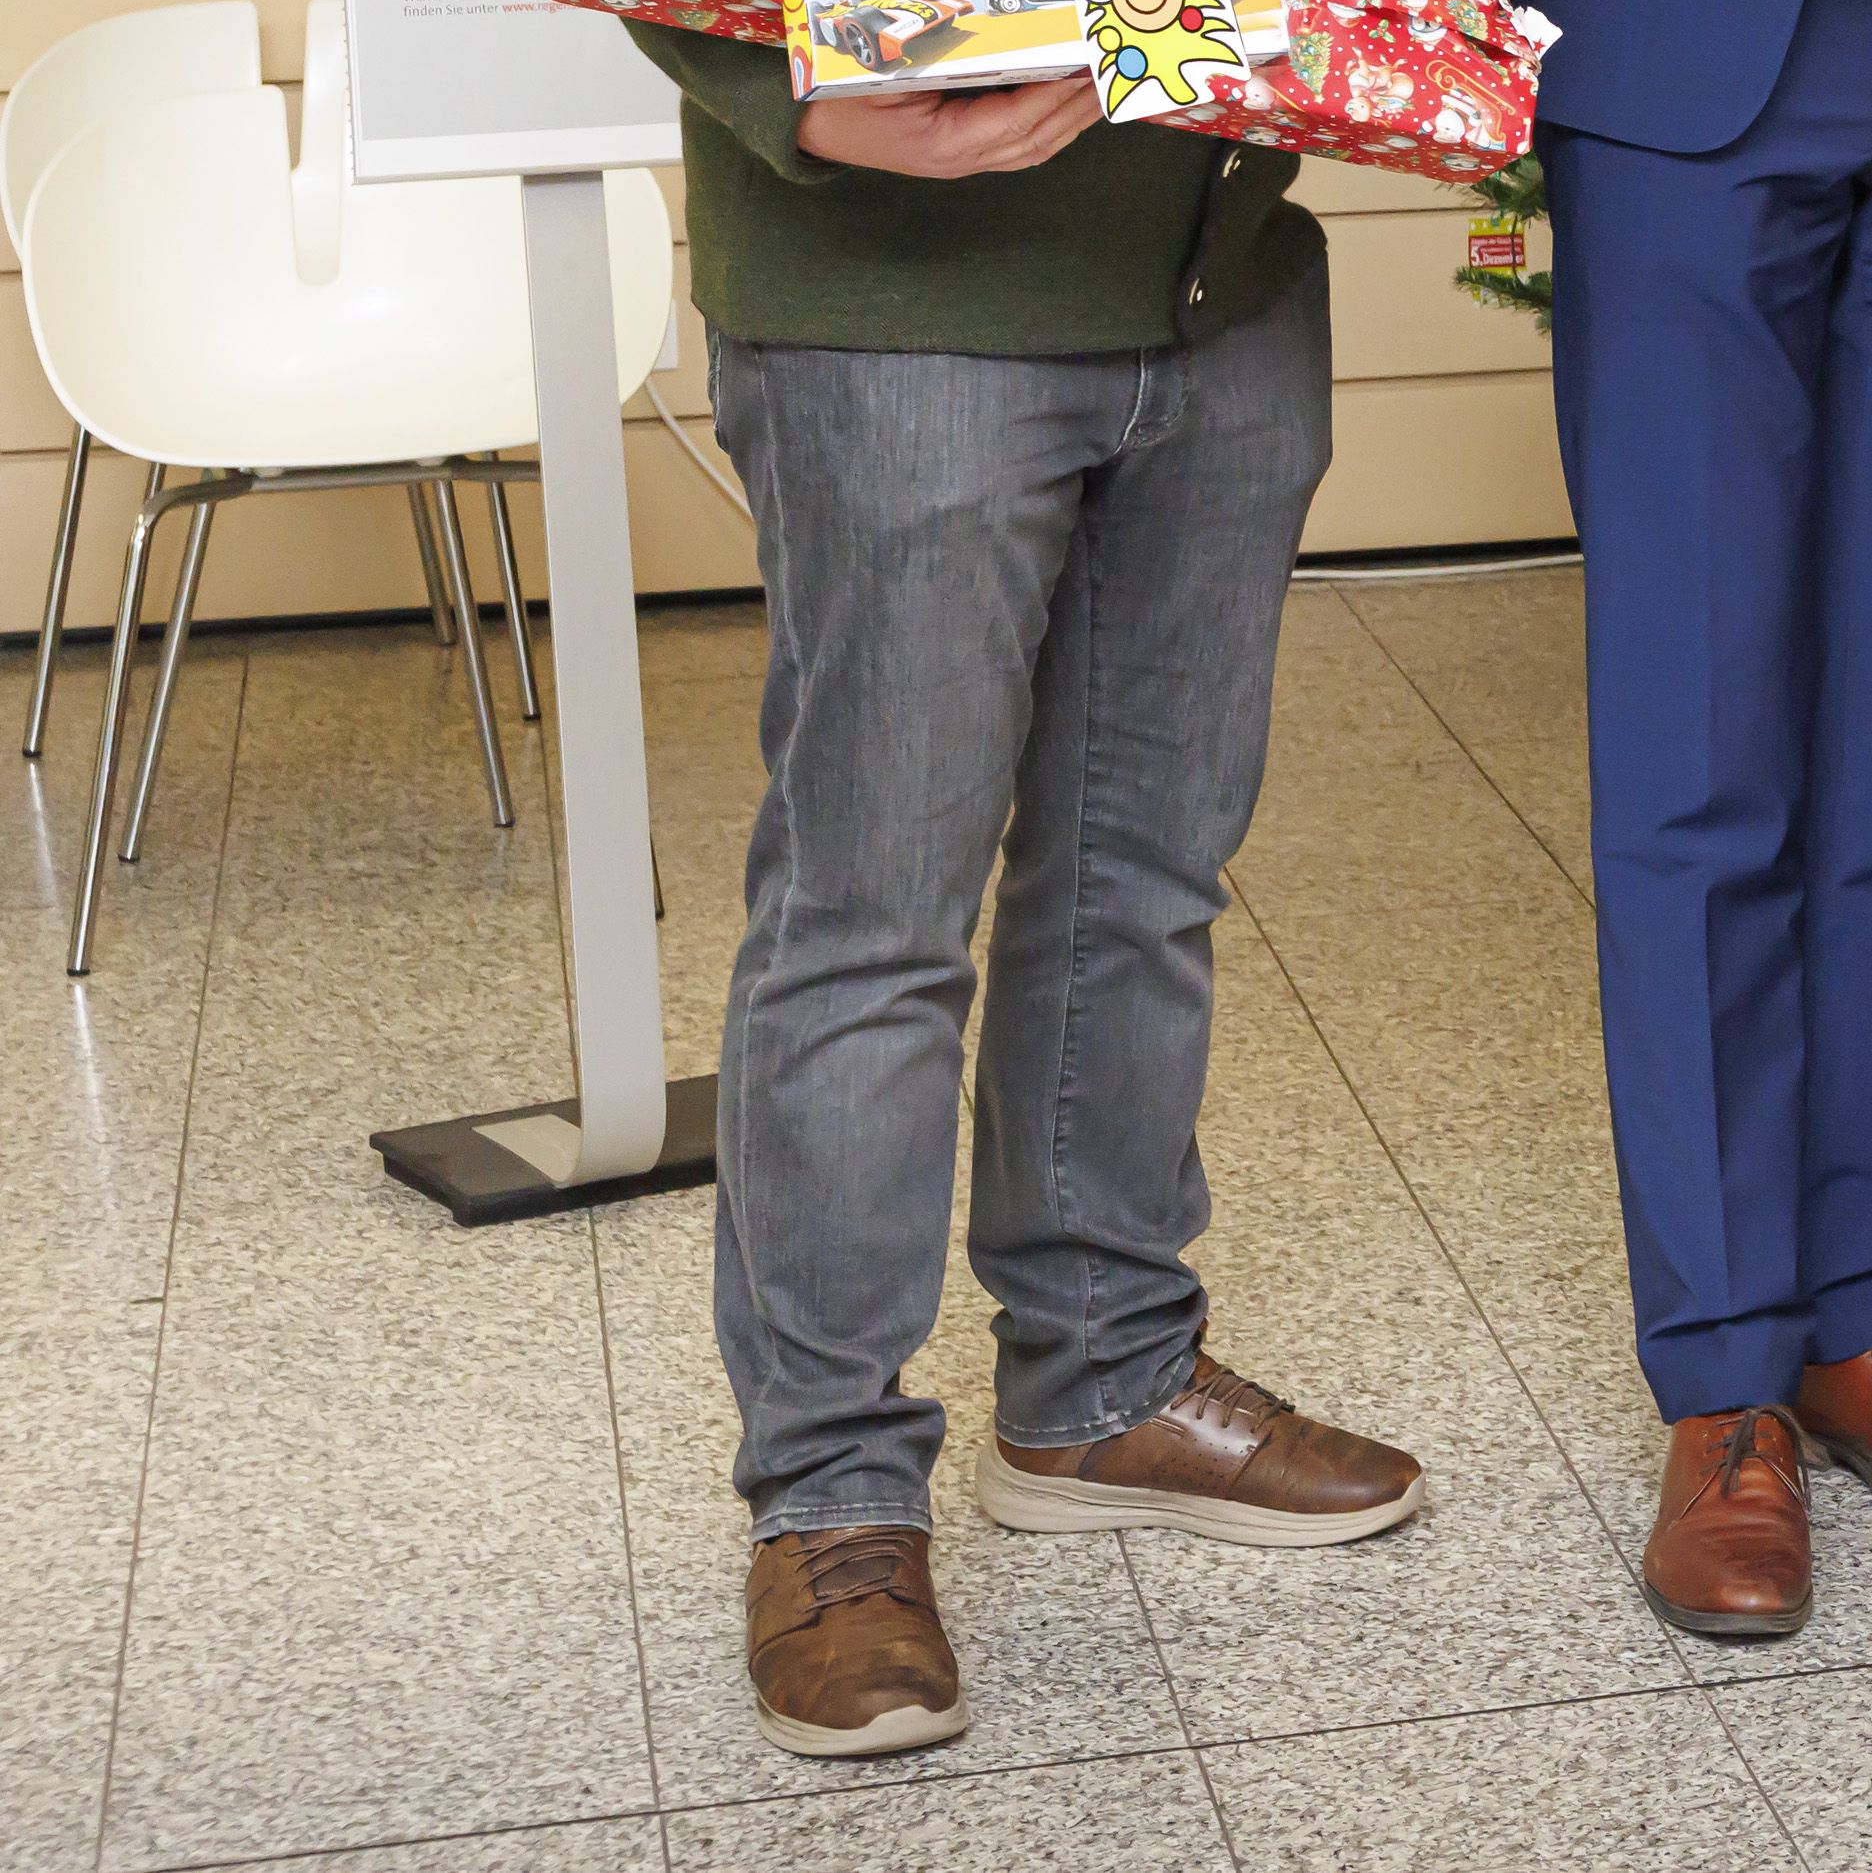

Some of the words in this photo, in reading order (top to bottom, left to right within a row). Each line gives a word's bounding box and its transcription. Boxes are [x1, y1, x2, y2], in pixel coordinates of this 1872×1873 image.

[403, 5, 442, 17] finden
[446, 5, 463, 15] Sie
[466, 3, 498, 14] unter
